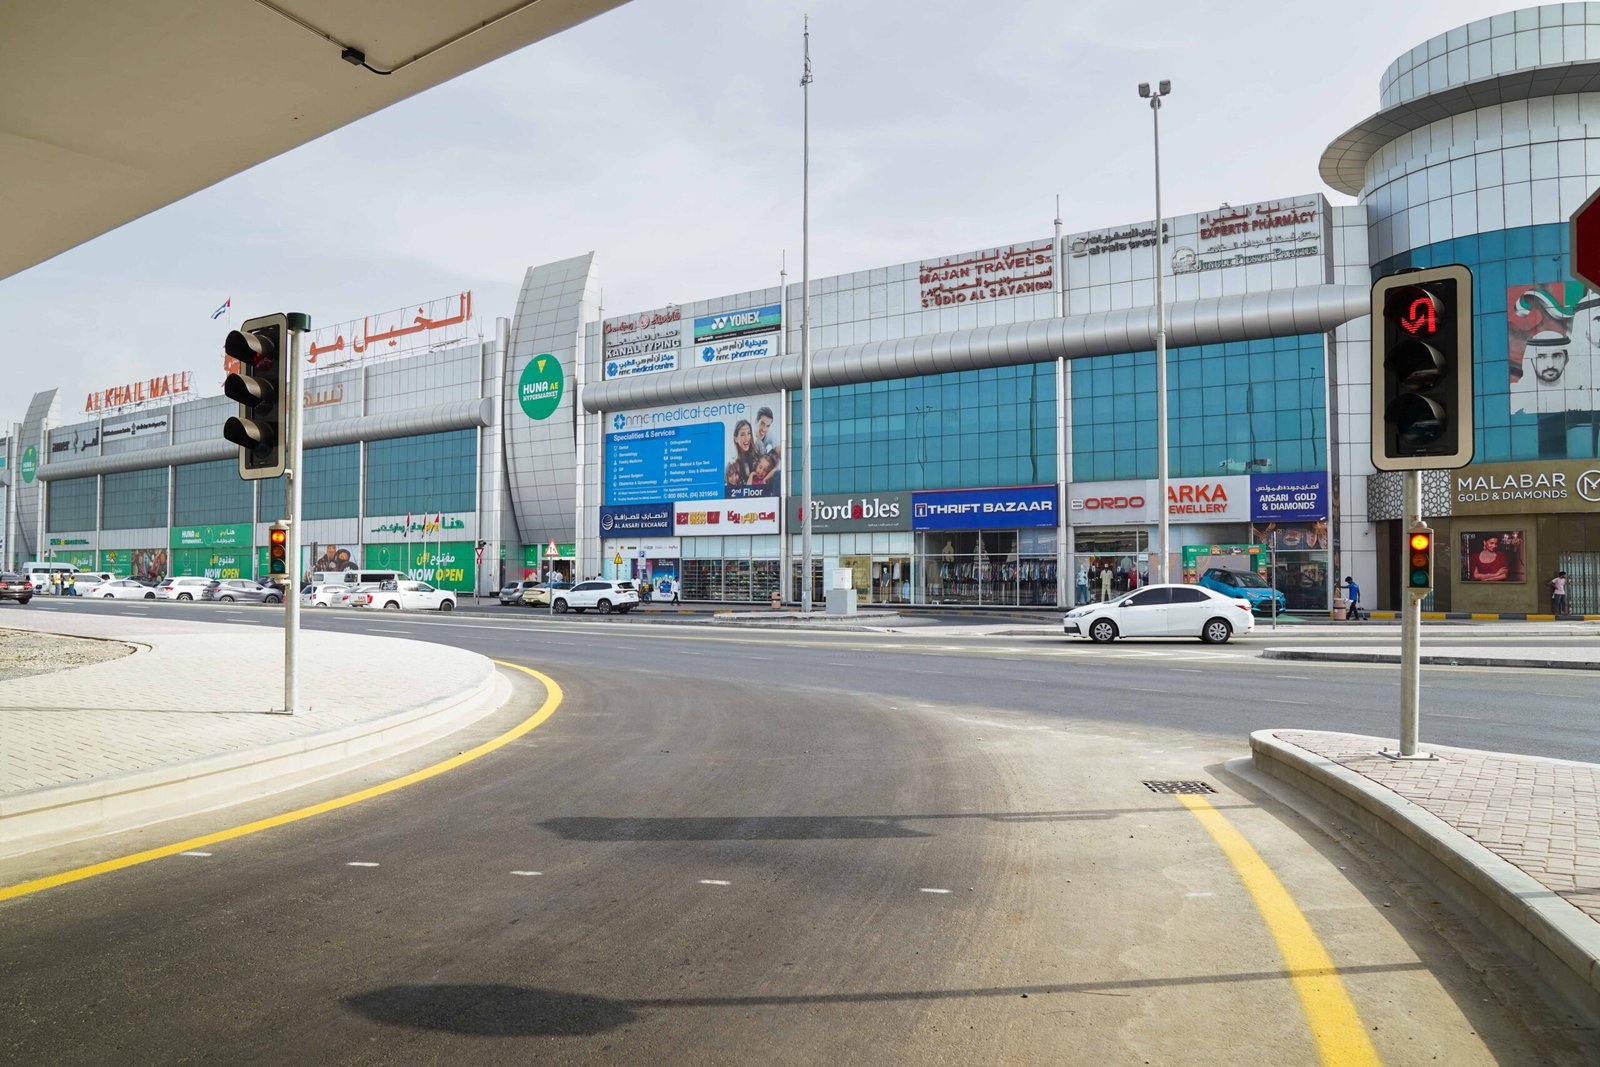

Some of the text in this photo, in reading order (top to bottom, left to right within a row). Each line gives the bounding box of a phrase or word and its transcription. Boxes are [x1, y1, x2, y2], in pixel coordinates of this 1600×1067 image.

[1200, 210, 1316, 240] EXPERTS PHARMACY
[1101, 242, 1127, 253] rais
[1129, 234, 1168, 249] travl
[920, 267, 969, 285] MAJAN
[975, 254, 1044, 275] TRAVELS
[922, 293, 966, 308] STUDIO
[970, 289, 986, 301] AL
[353, 289, 473, 353] الخيل
[730, 311, 760, 327] YONEX
[606, 339, 681, 359] KANAL TYPING
[731, 348, 768, 360] pharmacy
[632, 364, 654, 374] medical
[654, 362, 674, 370] centre
[85, 371, 189, 412] AL KHAIL MALL
[523, 381, 559, 395] HUNA AE
[523, 390, 558, 402] HYPERMARKET
[625, 402, 746, 426] nmc medical centre
[613, 432, 645, 442] Specialities
[650, 429, 676, 438] Services
[1458, 472, 1566, 491] MALABAR
[731, 487, 763, 497] 2nd Floor
[1259, 492, 1317, 502] ANSARI GOLD
[1458, 489, 1568, 502] GOLD & DIAMONDS
[927, 500, 1053, 516] THRIFT BAZAAR
[1167, 503, 1227, 514] EWELLERY
[1261, 501, 1315, 511] & DIAMONDS
[641, 521, 668, 529] EXCHANGE
[430, 552, 456, 566] مفتوح
[204, 568, 240, 578] NOW OPEN
[409, 568, 464, 581] NOW OPEN
